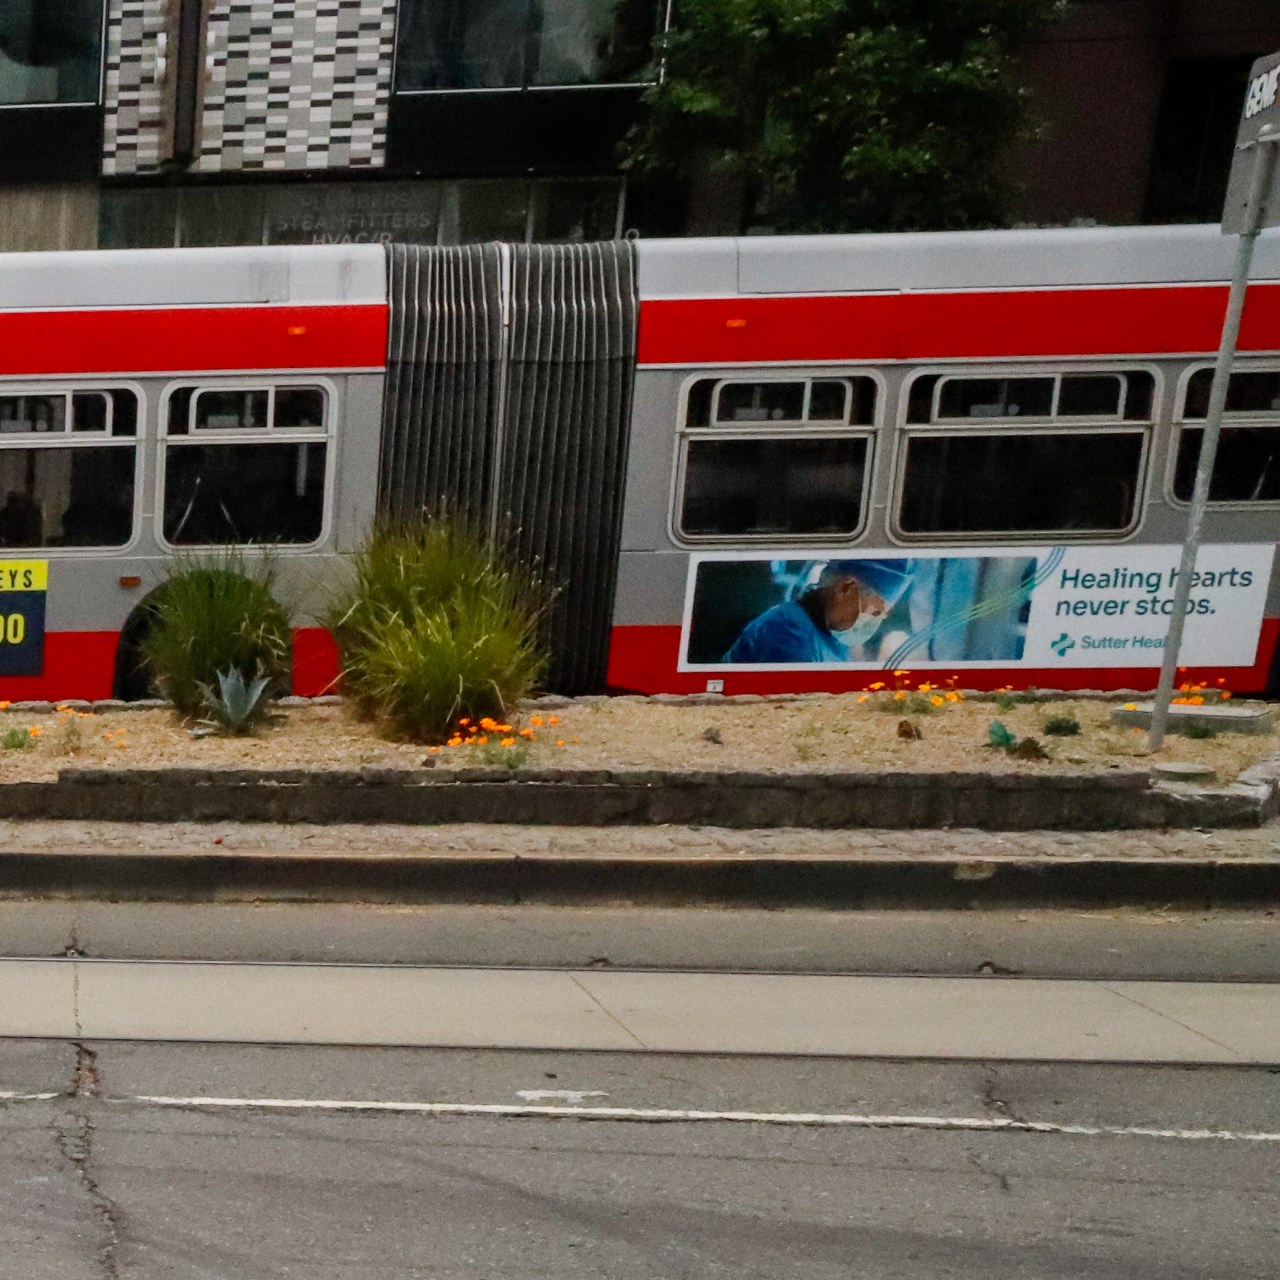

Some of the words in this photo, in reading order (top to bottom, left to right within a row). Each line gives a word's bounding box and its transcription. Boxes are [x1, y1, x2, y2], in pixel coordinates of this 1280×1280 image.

[312, 232, 392, 245] HVAC/R
[1060, 568, 1162, 593] Healing
[1055, 600, 1129, 617] never
[1080, 634, 1129, 650] Sutter
